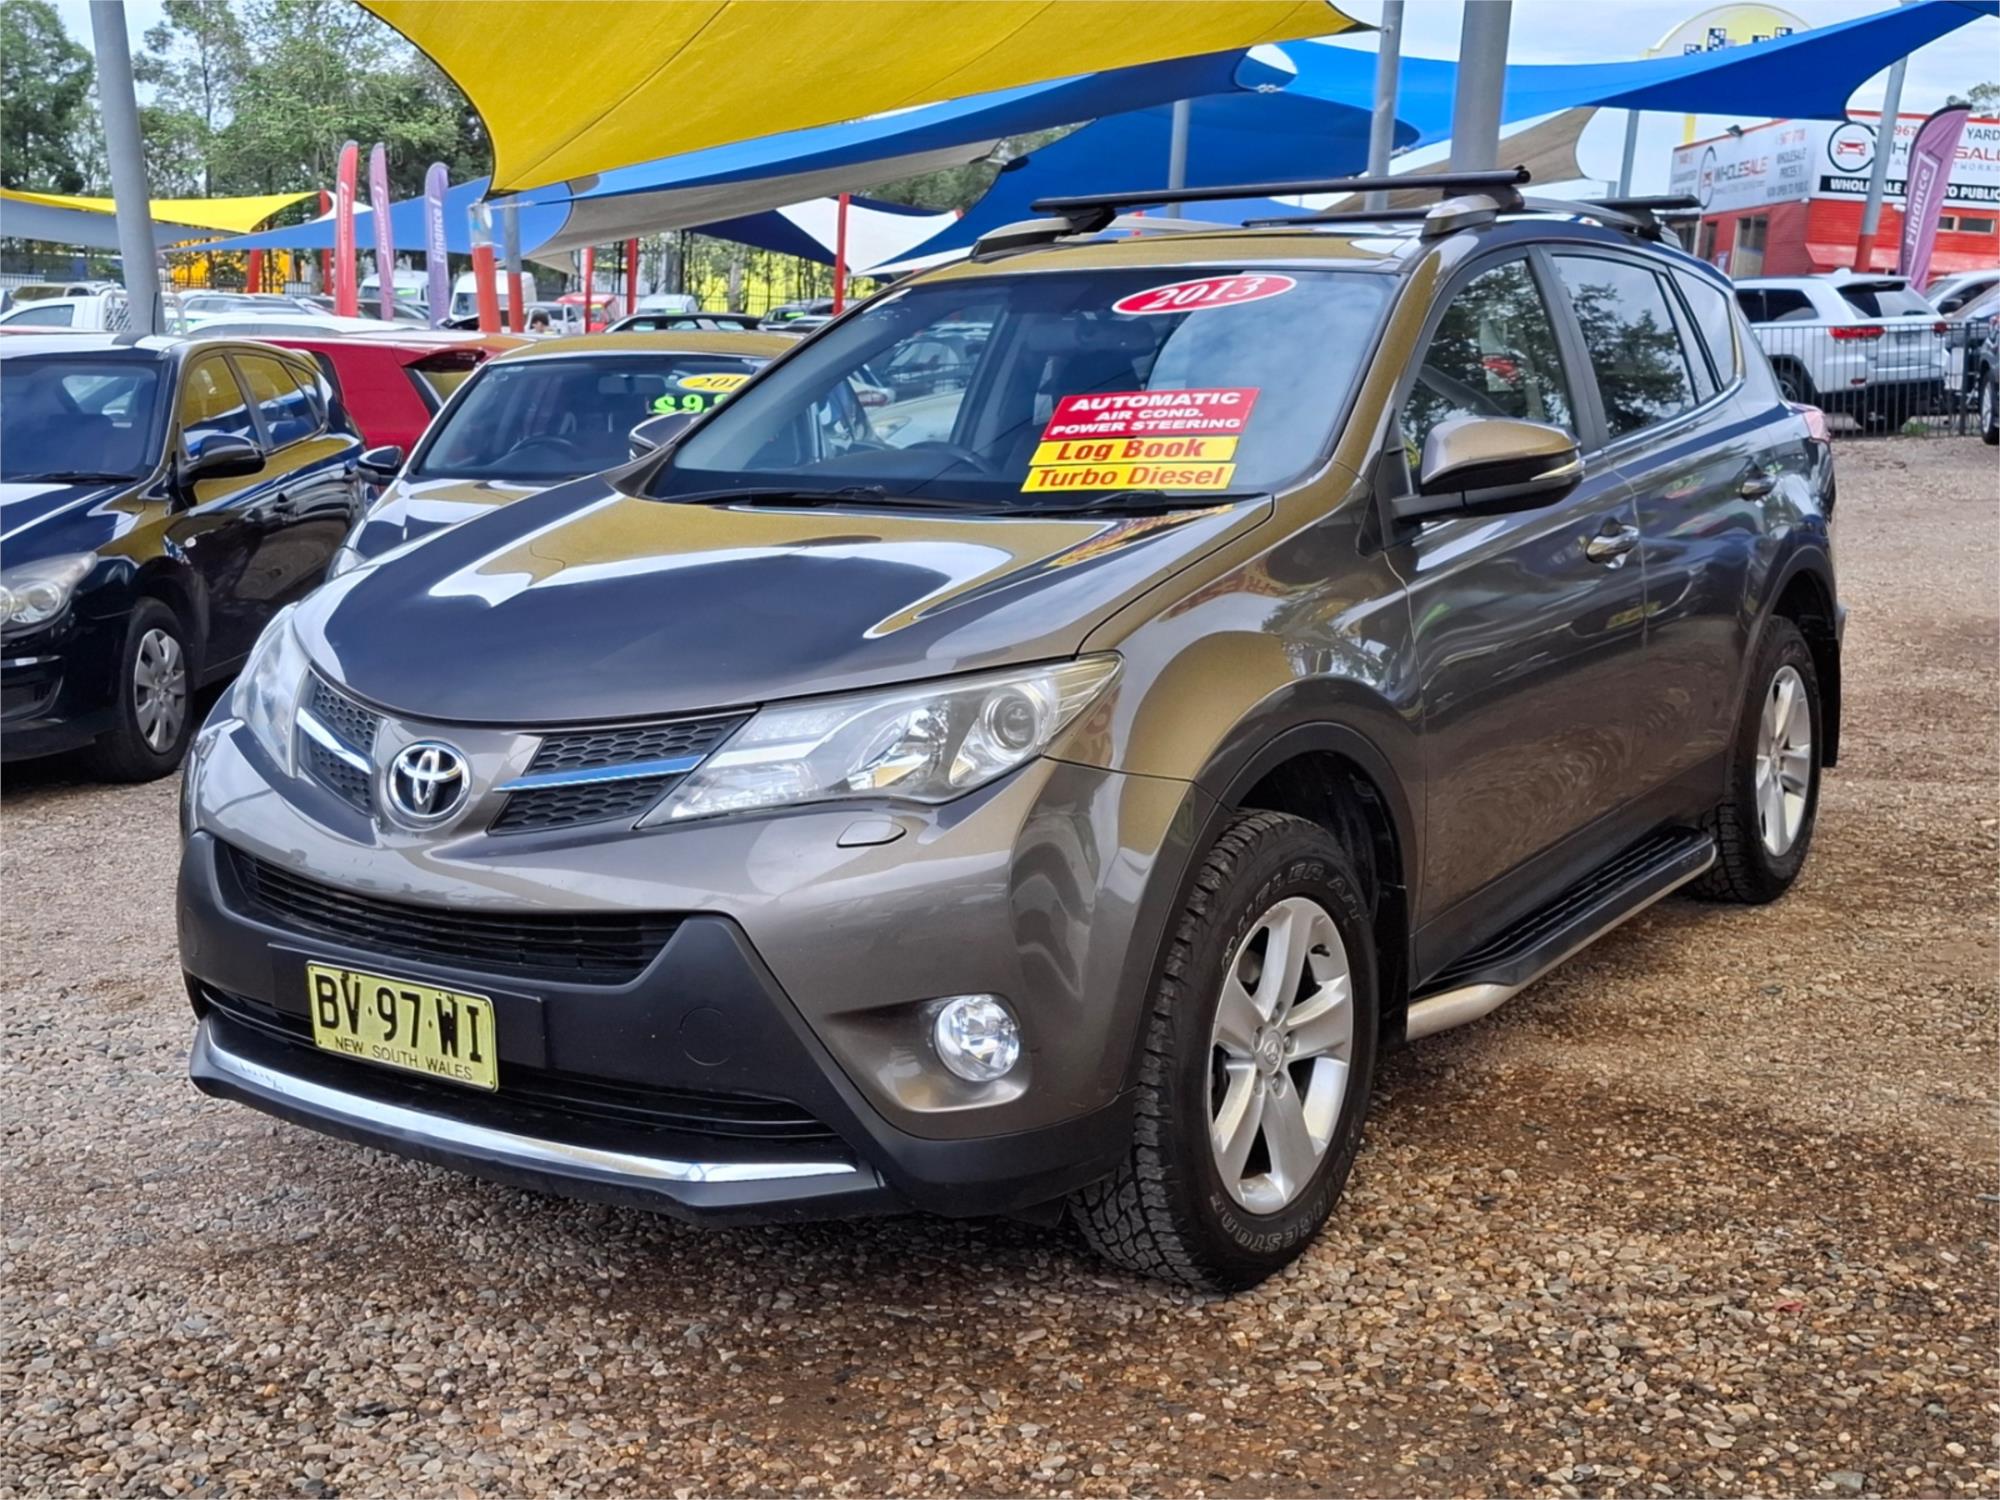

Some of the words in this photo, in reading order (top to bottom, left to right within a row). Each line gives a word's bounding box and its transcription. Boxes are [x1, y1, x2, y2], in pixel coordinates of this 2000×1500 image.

[1907, 168, 1930, 246] Finance
[432, 205, 445, 263] Finance
[1139, 277, 1267, 311] 2013
[1068, 392, 1241, 412] AUTOMATIC
[1094, 410, 1134, 421] AIR
[1138, 408, 1204, 419] COND.
[1050, 421, 1124, 436] POWER
[1130, 418, 1241, 432] STEERING
[1056, 441, 1114, 462] Log
[1121, 438, 1206, 459] Book
[1037, 469, 1118, 488] Turbo
[1126, 466, 1225, 485] Diesel
[335, 1036, 364, 1055] NEW
[373, 1045, 418, 1068] SOUTH
[426, 1056, 473, 1081] WALES
